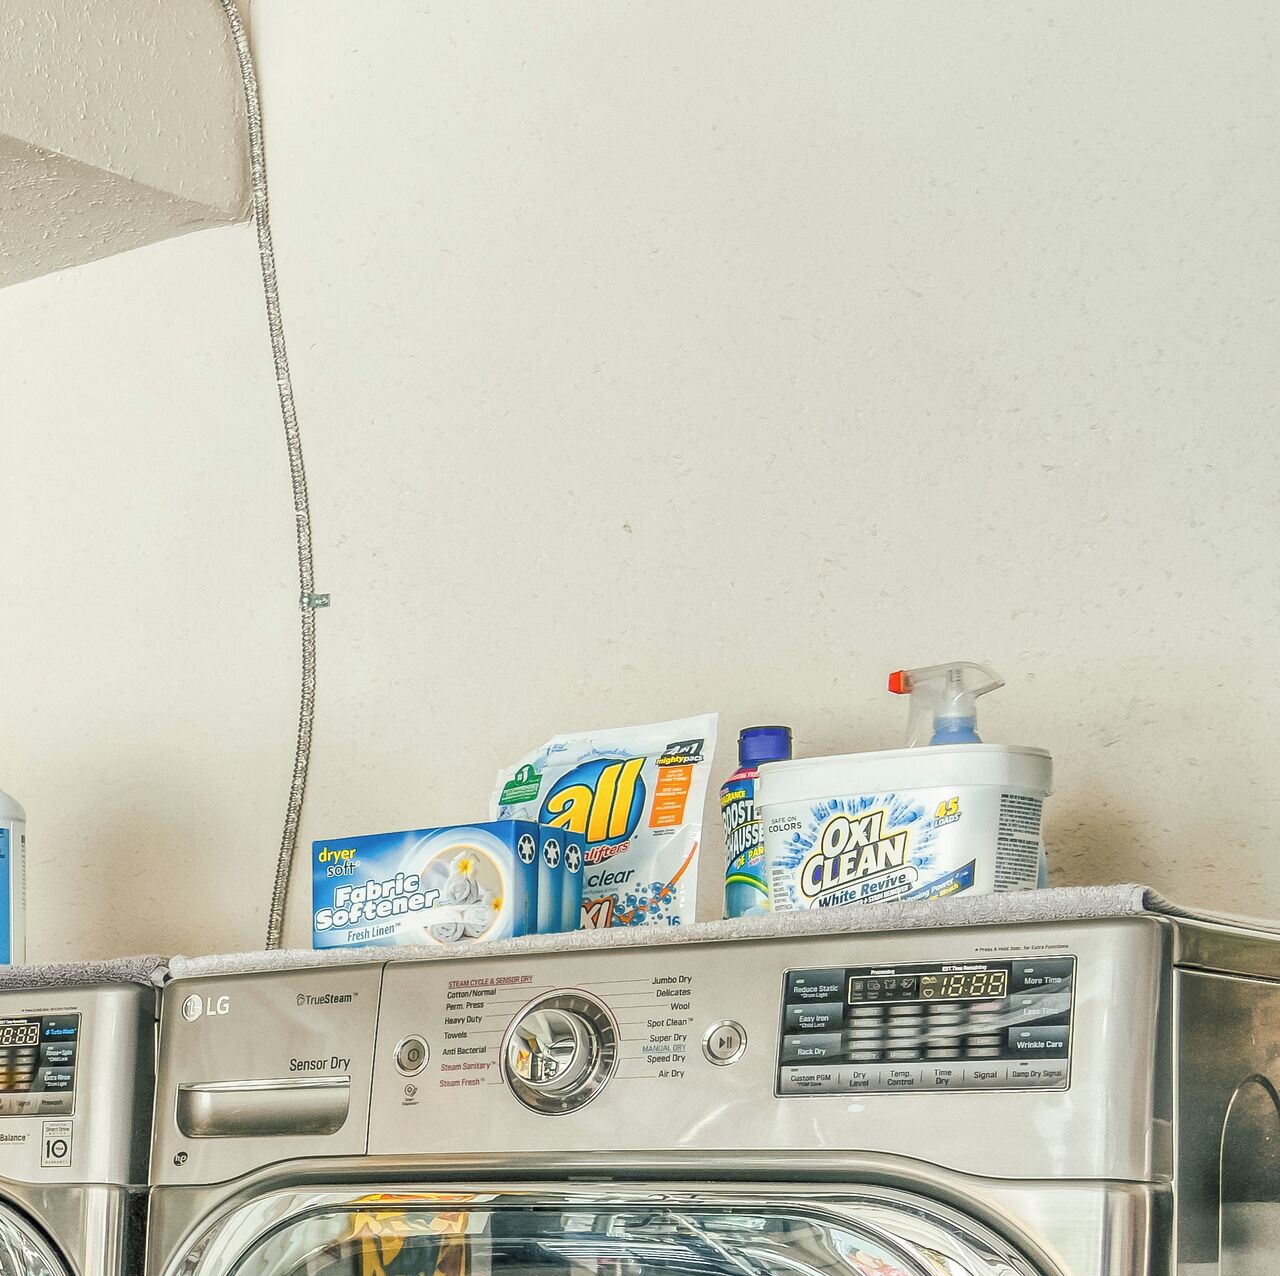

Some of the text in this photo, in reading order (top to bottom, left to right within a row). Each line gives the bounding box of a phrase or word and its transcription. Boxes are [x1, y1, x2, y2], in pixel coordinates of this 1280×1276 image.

[546, 758, 646, 843] all
[934, 797, 960, 818] 45
[769, 822, 802, 833] COLORS
[822, 811, 884, 859] OXI
[319, 847, 356, 864] dryer
[584, 840, 630, 863] nlifters
[748, 846, 764, 858] PAR
[327, 861, 354, 878] soft
[801, 831, 908, 897] CLEAN
[588, 869, 634, 887] clear
[334, 872, 420, 908] Fabric
[818, 889, 856, 908] White
[860, 873, 906, 897] Revive
[316, 889, 440, 931] Softener
[581, 899, 612, 929] XI
[666, 916, 680, 926] 16
[348, 930, 370, 942] Fresh
[679, 975, 692, 984] Dry
[447, 989, 496, 999] Cotton/Normal
[656, 989, 691, 997] Delicates
[206, 996, 230, 1016] LG
[671, 1002, 690, 1010] Wool
[647, 1019, 664, 1028] Spot
[444, 1031, 467, 1040] Towels
[650, 1033, 687, 1043] Super Dry
[457, 1046, 486, 1054] Bacterial
[815, 1047, 826, 1056] Dry
[290, 1056, 350, 1071] Sensor Dry
[647, 1053, 686, 1064] Speed Dry
[671, 1069, 684, 1078] Dry
[853, 1072, 866, 1080] Dry
[974, 1071, 997, 1080] Signal
[887, 1078, 914, 1086] Control
[935, 1076, 948, 1085] Dry
[46, 1140, 67, 1158] 10
